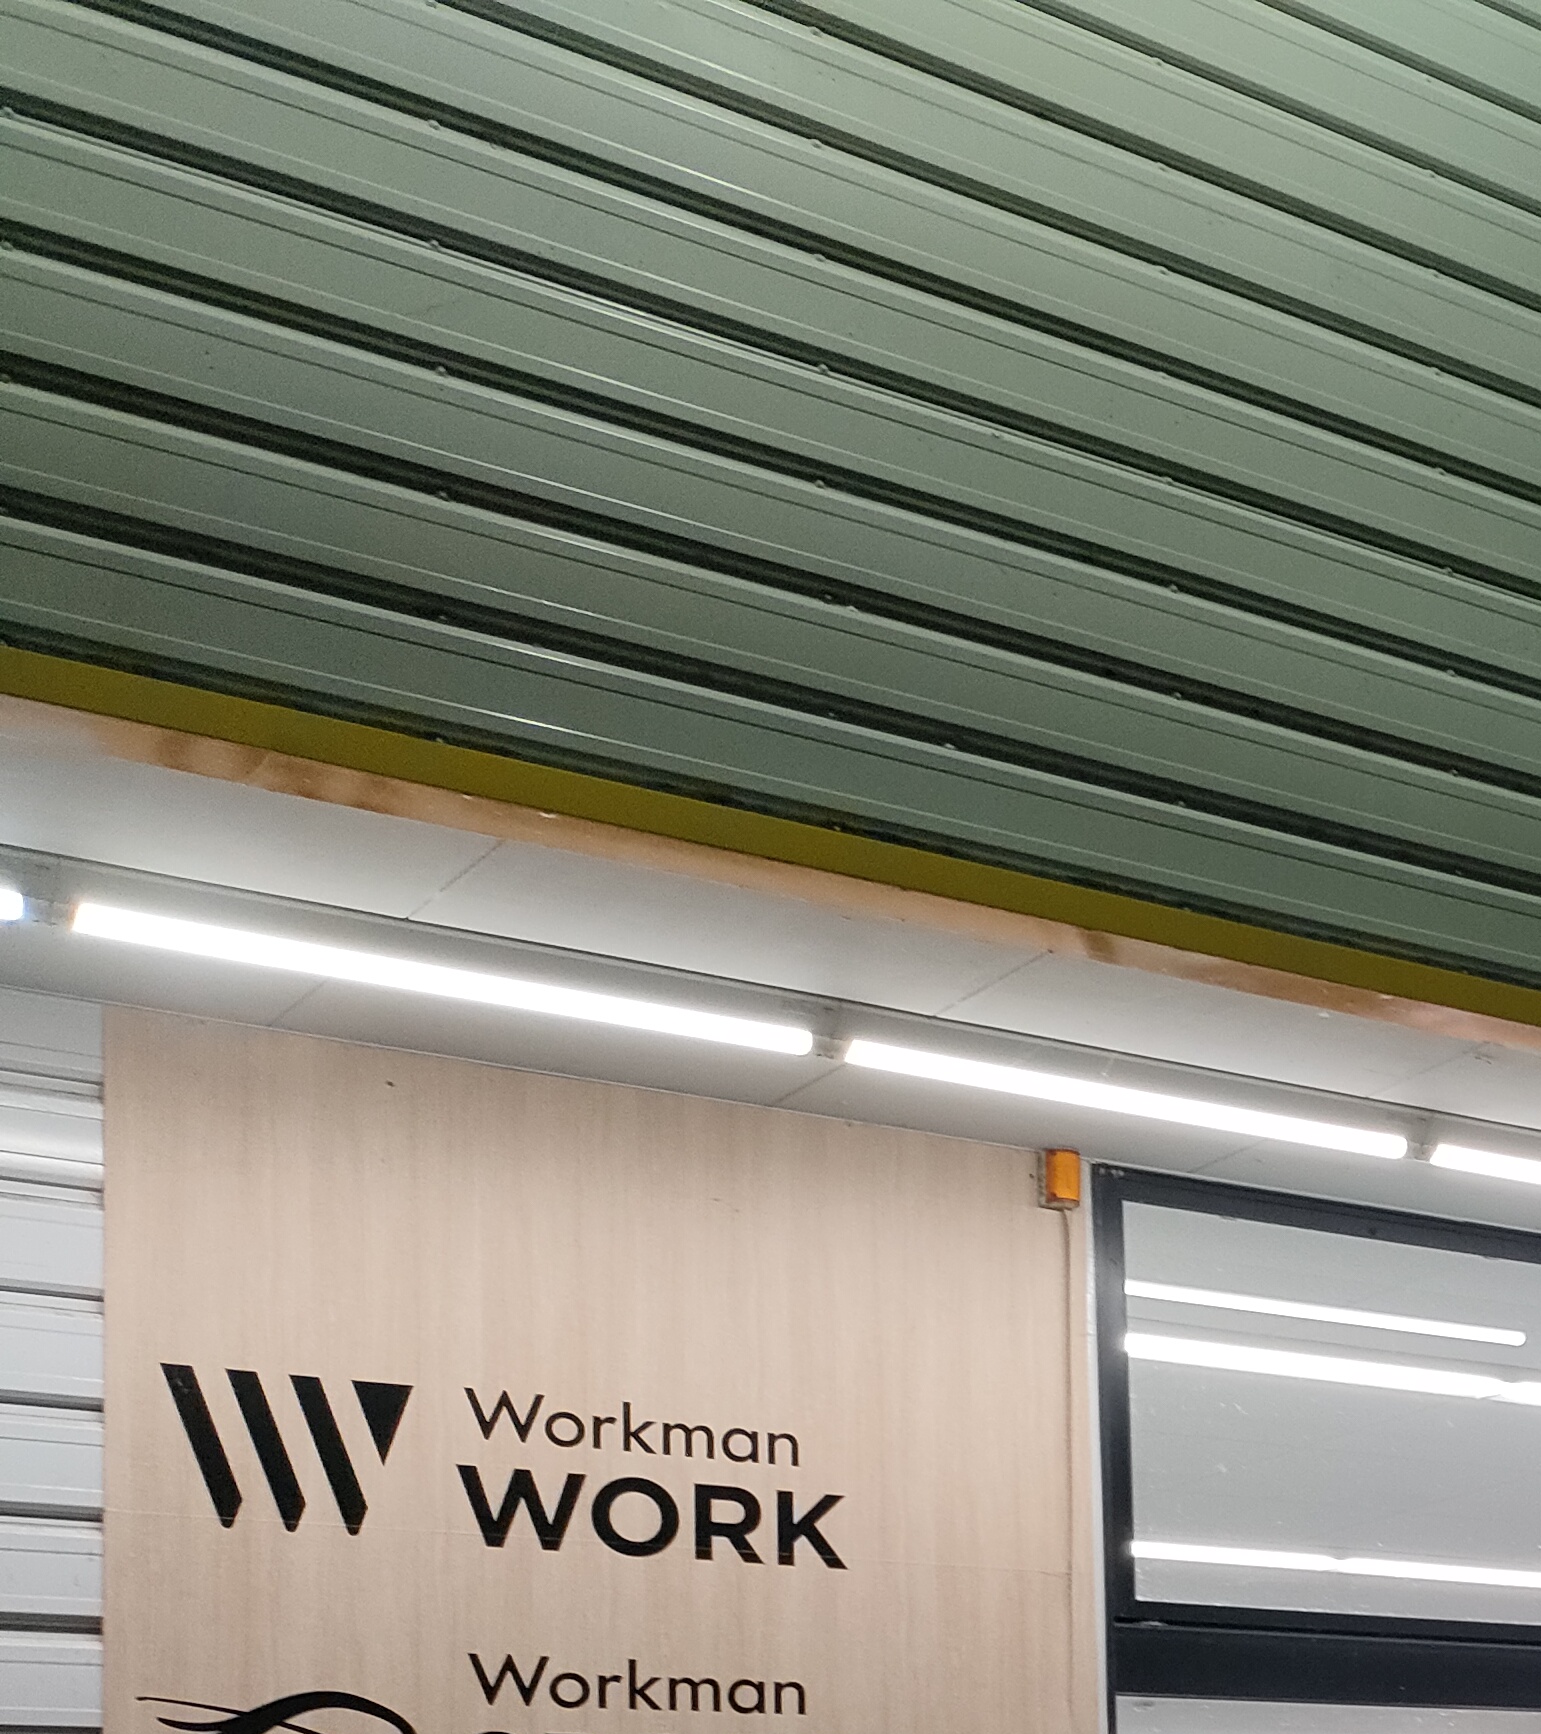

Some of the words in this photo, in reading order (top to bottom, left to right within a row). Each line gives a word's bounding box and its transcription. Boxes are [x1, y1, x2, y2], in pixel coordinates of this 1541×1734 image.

[463, 1387, 801, 1467] Workman
[455, 1463, 849, 1570] WORK
[467, 1652, 806, 1715] Workman
